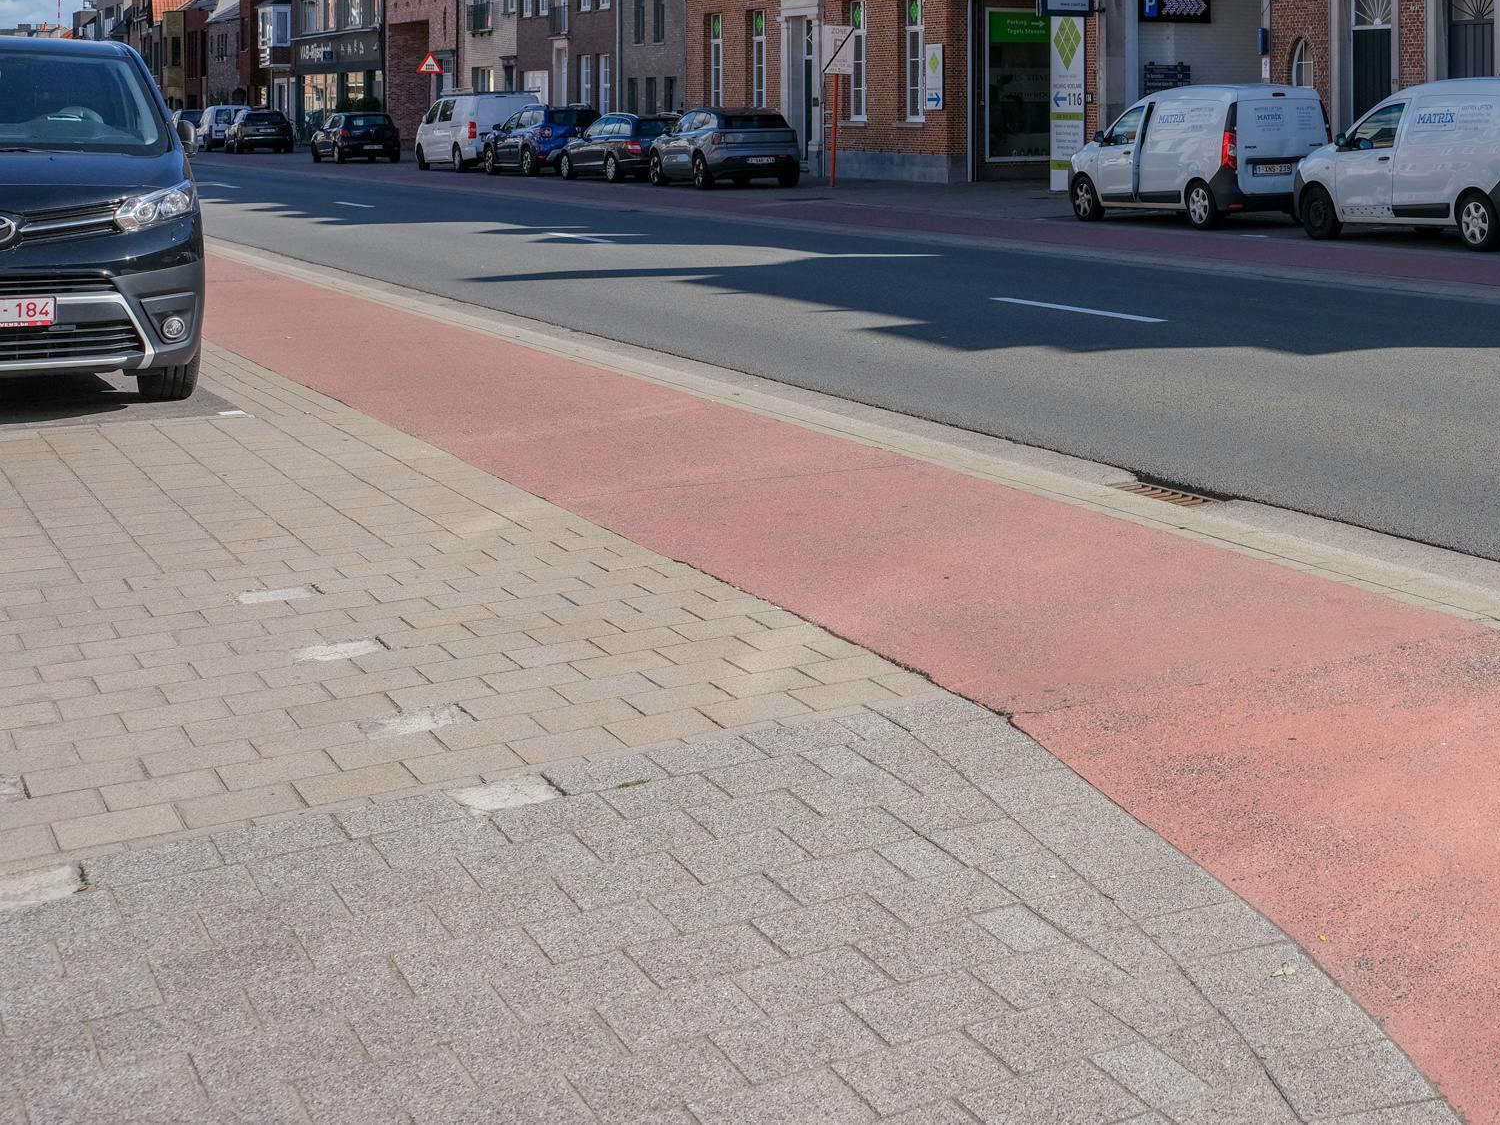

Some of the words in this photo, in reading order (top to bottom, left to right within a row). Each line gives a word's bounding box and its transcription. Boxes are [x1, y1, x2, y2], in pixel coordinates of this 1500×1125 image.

[1068, 92, 1082, 106] 116
[1158, 112, 1186, 124] MATRIX
[1417, 109, 1456, 124] MATRIX
